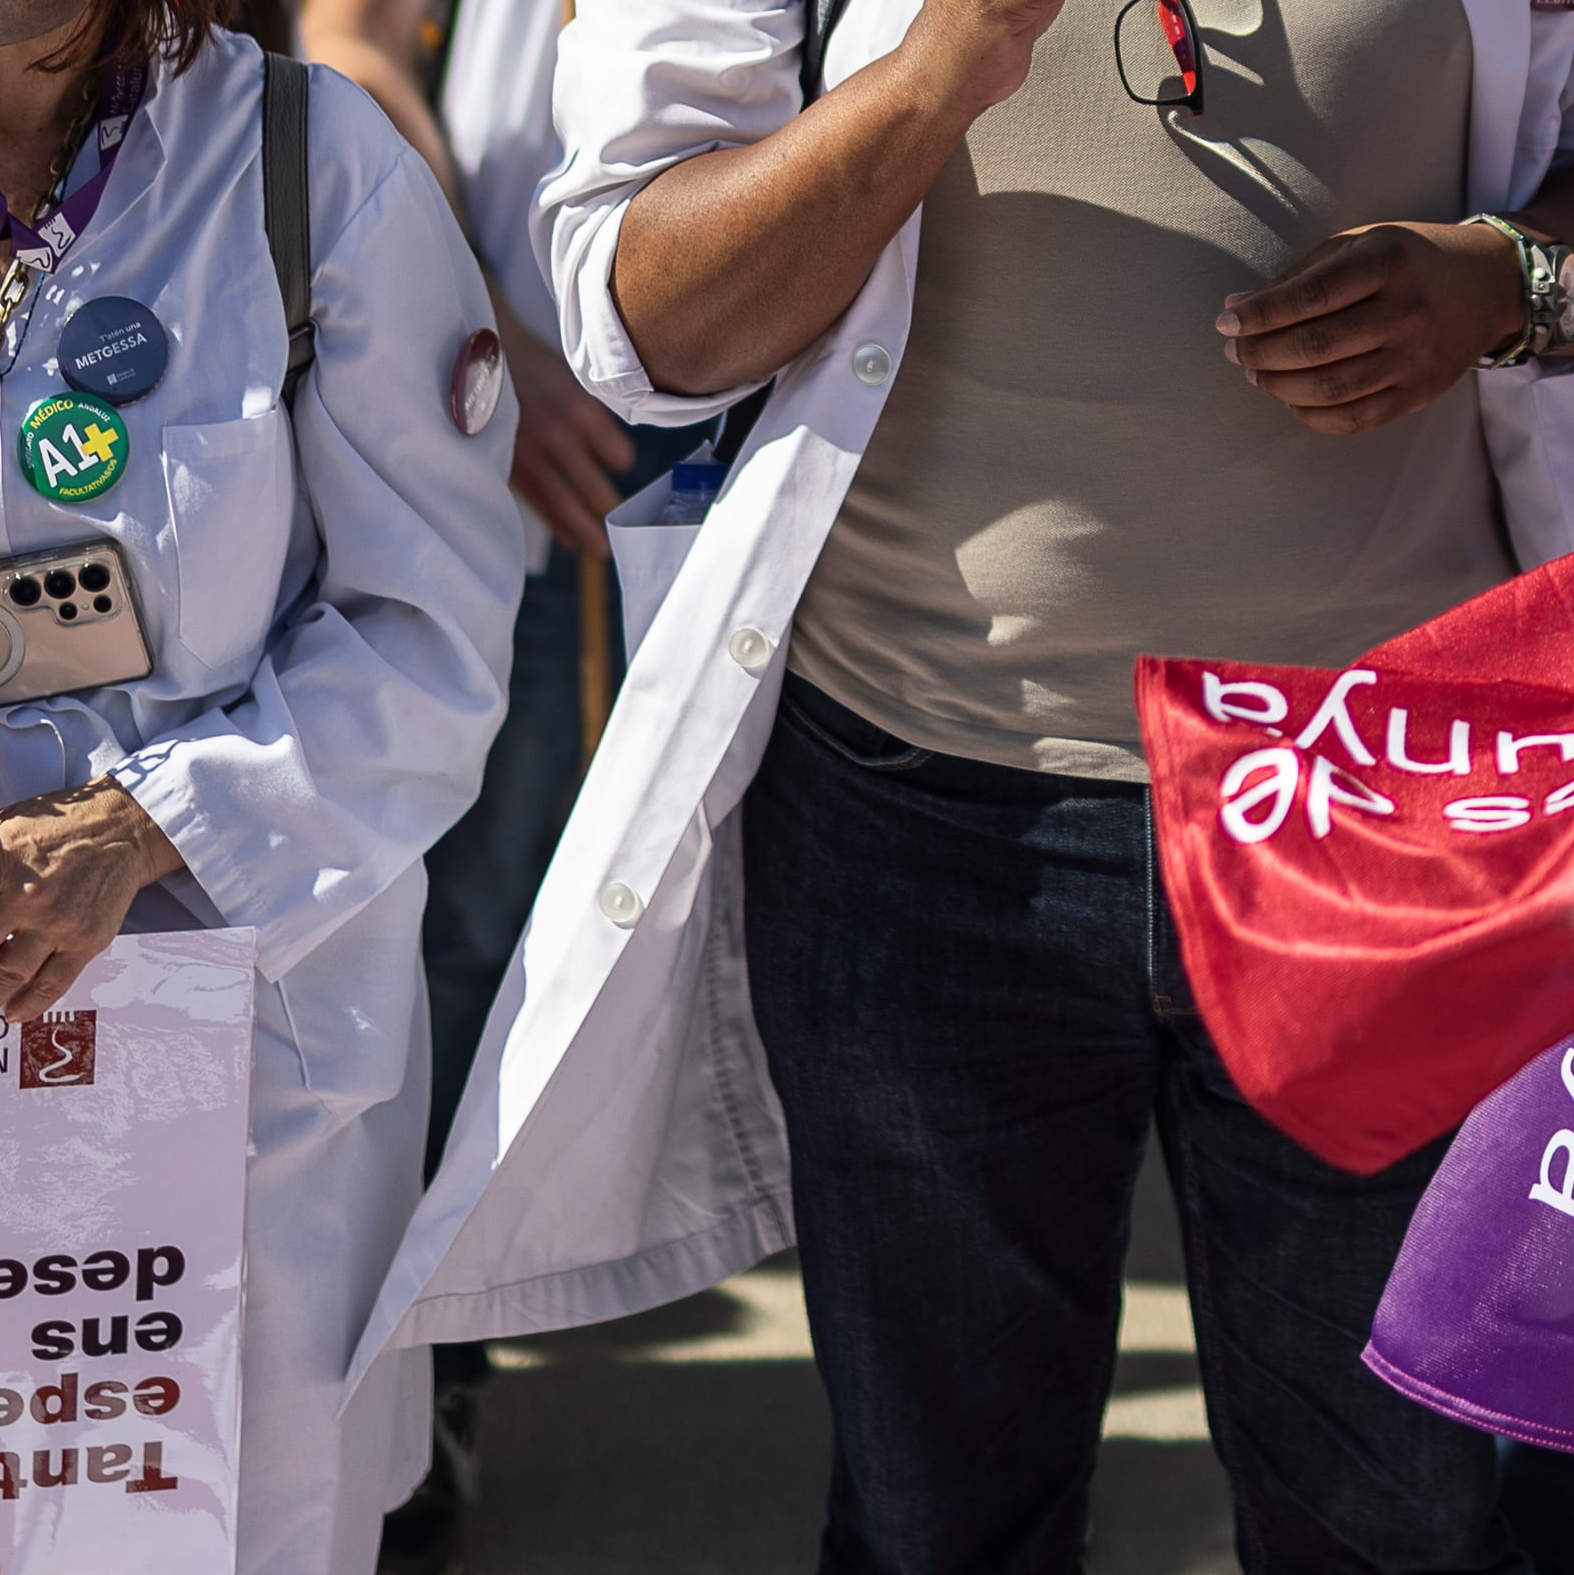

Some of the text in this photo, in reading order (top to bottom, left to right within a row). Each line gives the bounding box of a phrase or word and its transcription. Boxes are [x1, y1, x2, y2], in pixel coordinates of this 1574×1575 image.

[125, 322, 142, 333] una
[75, 333, 148, 370] METGESSA
[29, 399, 74, 429] MÉDICO
[77, 403, 111, 423] ANDALUZ
[31, 1310, 182, 1360] ens
